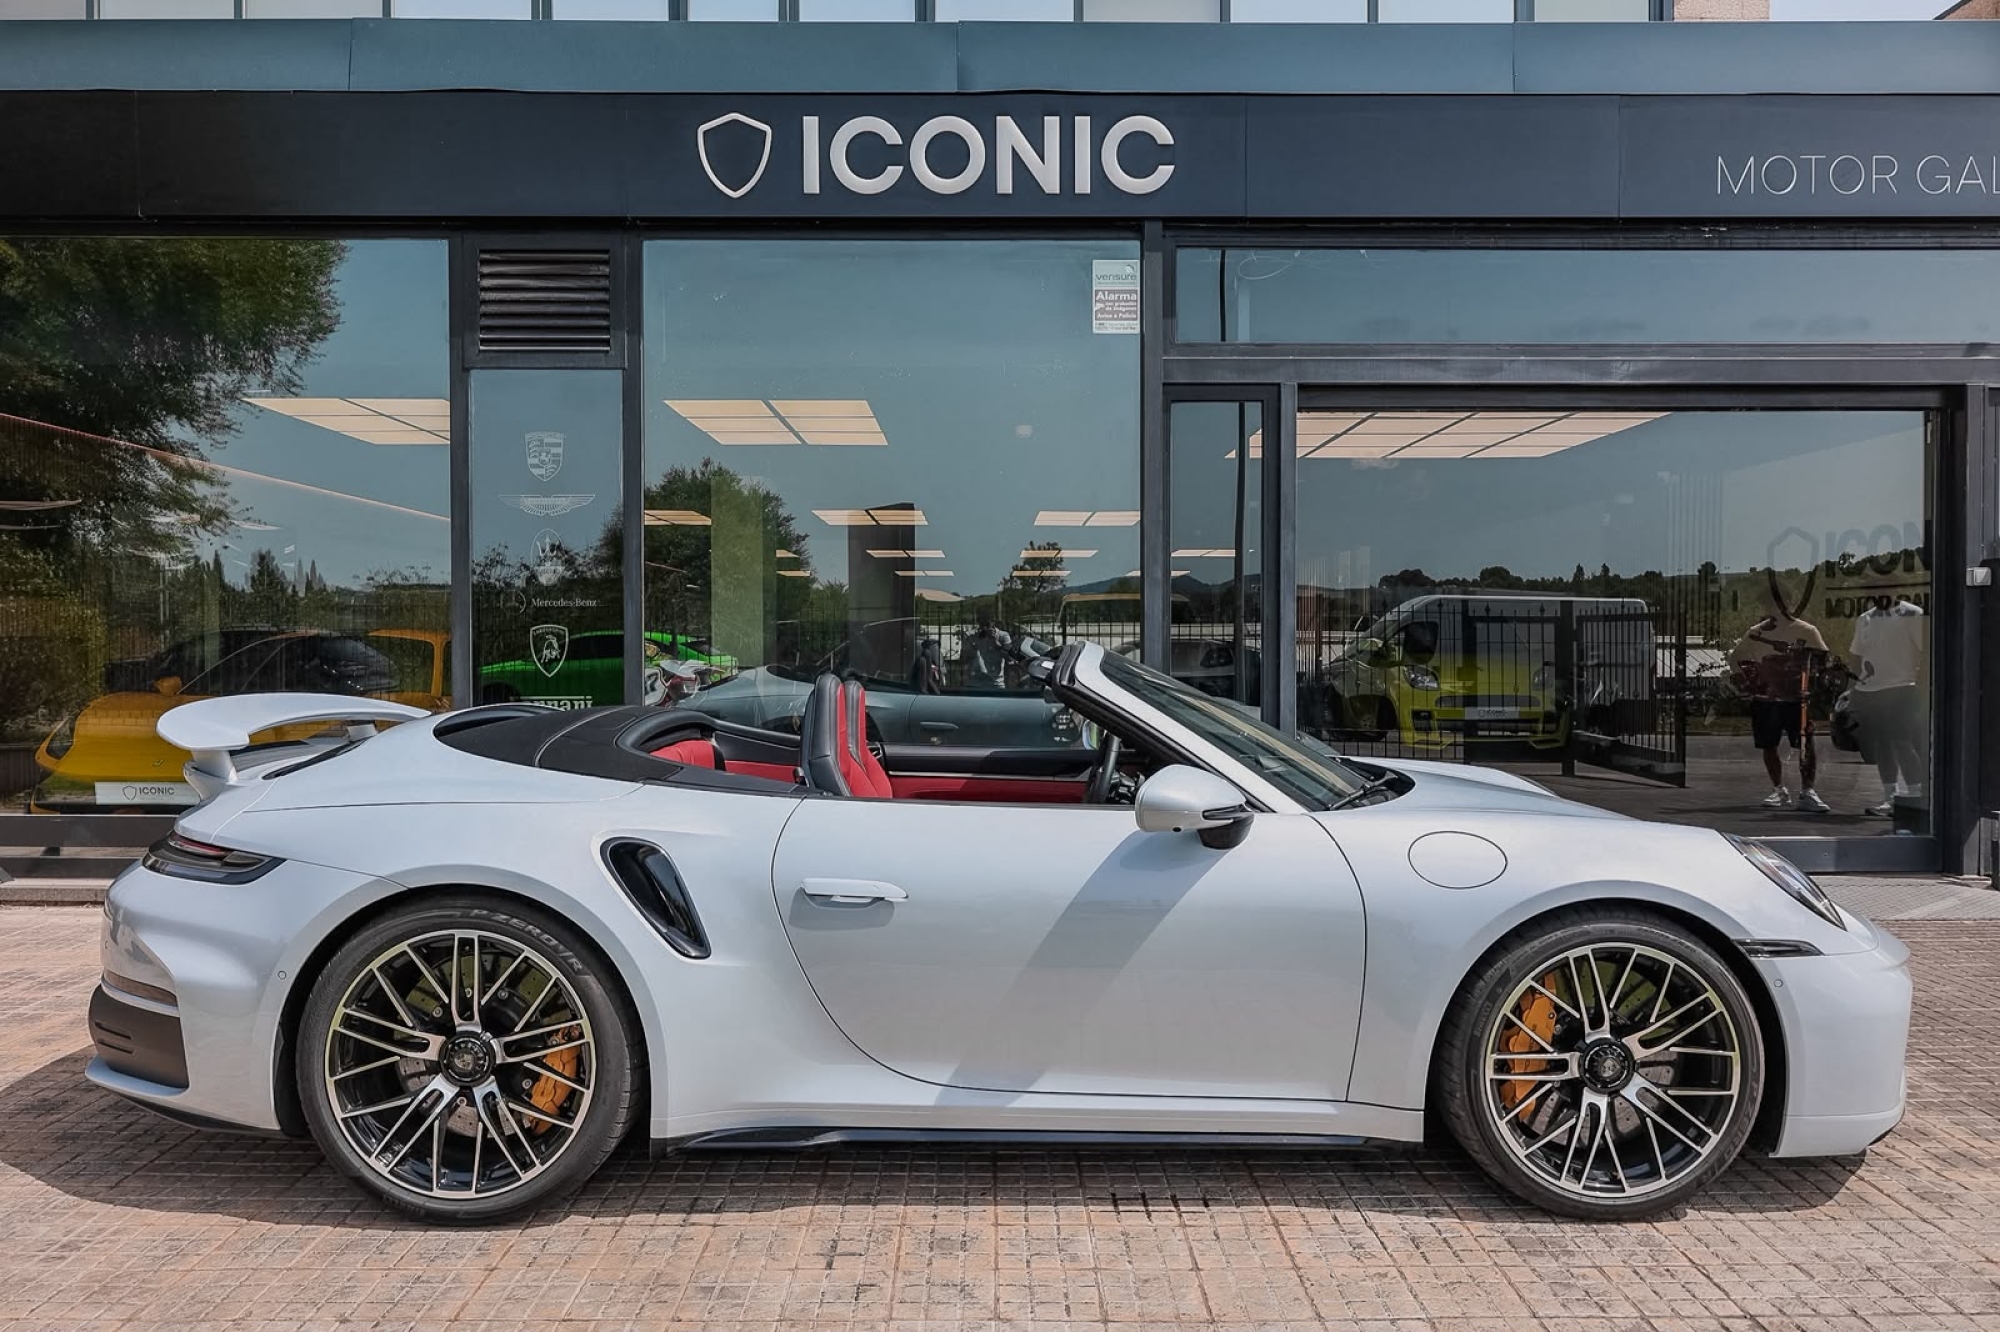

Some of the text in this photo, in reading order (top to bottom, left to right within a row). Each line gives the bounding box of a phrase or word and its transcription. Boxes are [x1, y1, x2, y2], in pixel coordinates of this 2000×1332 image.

[803, 116, 1175, 195] ICONIC
[1717, 154, 2000, 195] MOTOR GAL
[1096, 290, 1136, 301] Alarma
[531, 598, 597, 607] Mercedes-Benz
[139, 786, 175, 796] ICONIC
